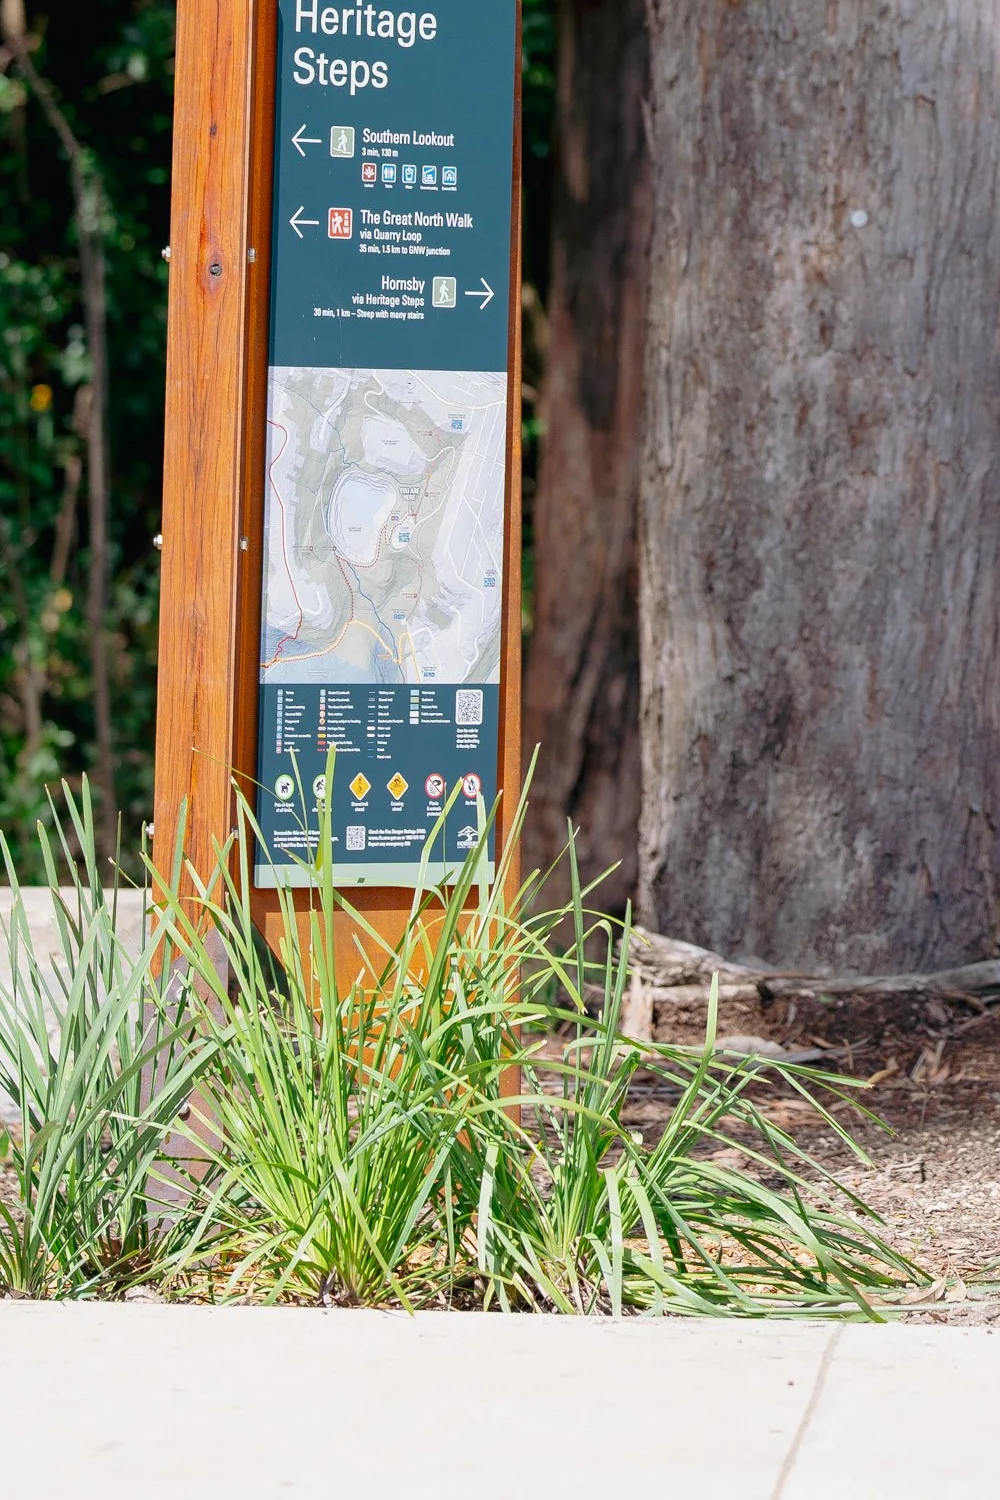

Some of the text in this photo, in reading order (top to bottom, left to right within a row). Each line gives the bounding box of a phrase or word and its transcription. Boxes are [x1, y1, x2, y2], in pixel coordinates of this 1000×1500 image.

[293, 47, 388, 95] Steps
[363, 128, 454, 146] Southern Lookout
[362, 147, 366, 156] 3
[360, 210, 473, 228] The Great North Walk
[360, 228, 421, 243] via Quarry Loop
[359, 244, 367, 252] 35
[382, 245, 390, 253] 1.5
[391, 245, 400, 253] km
[401, 246, 408, 254] to
[409, 246, 425, 254] GNW
[426, 246, 450, 256] junction
[382, 276, 425, 294] Hornsby
[352, 294, 424, 308] via Heritage Steps
[314, 308, 321, 316] 30
[341, 309, 350, 317] km
[357, 309, 374, 319] Steep
[375, 310, 389, 318] with
[390, 312, 406, 320] many
[407, 311, 424, 319] stairs
